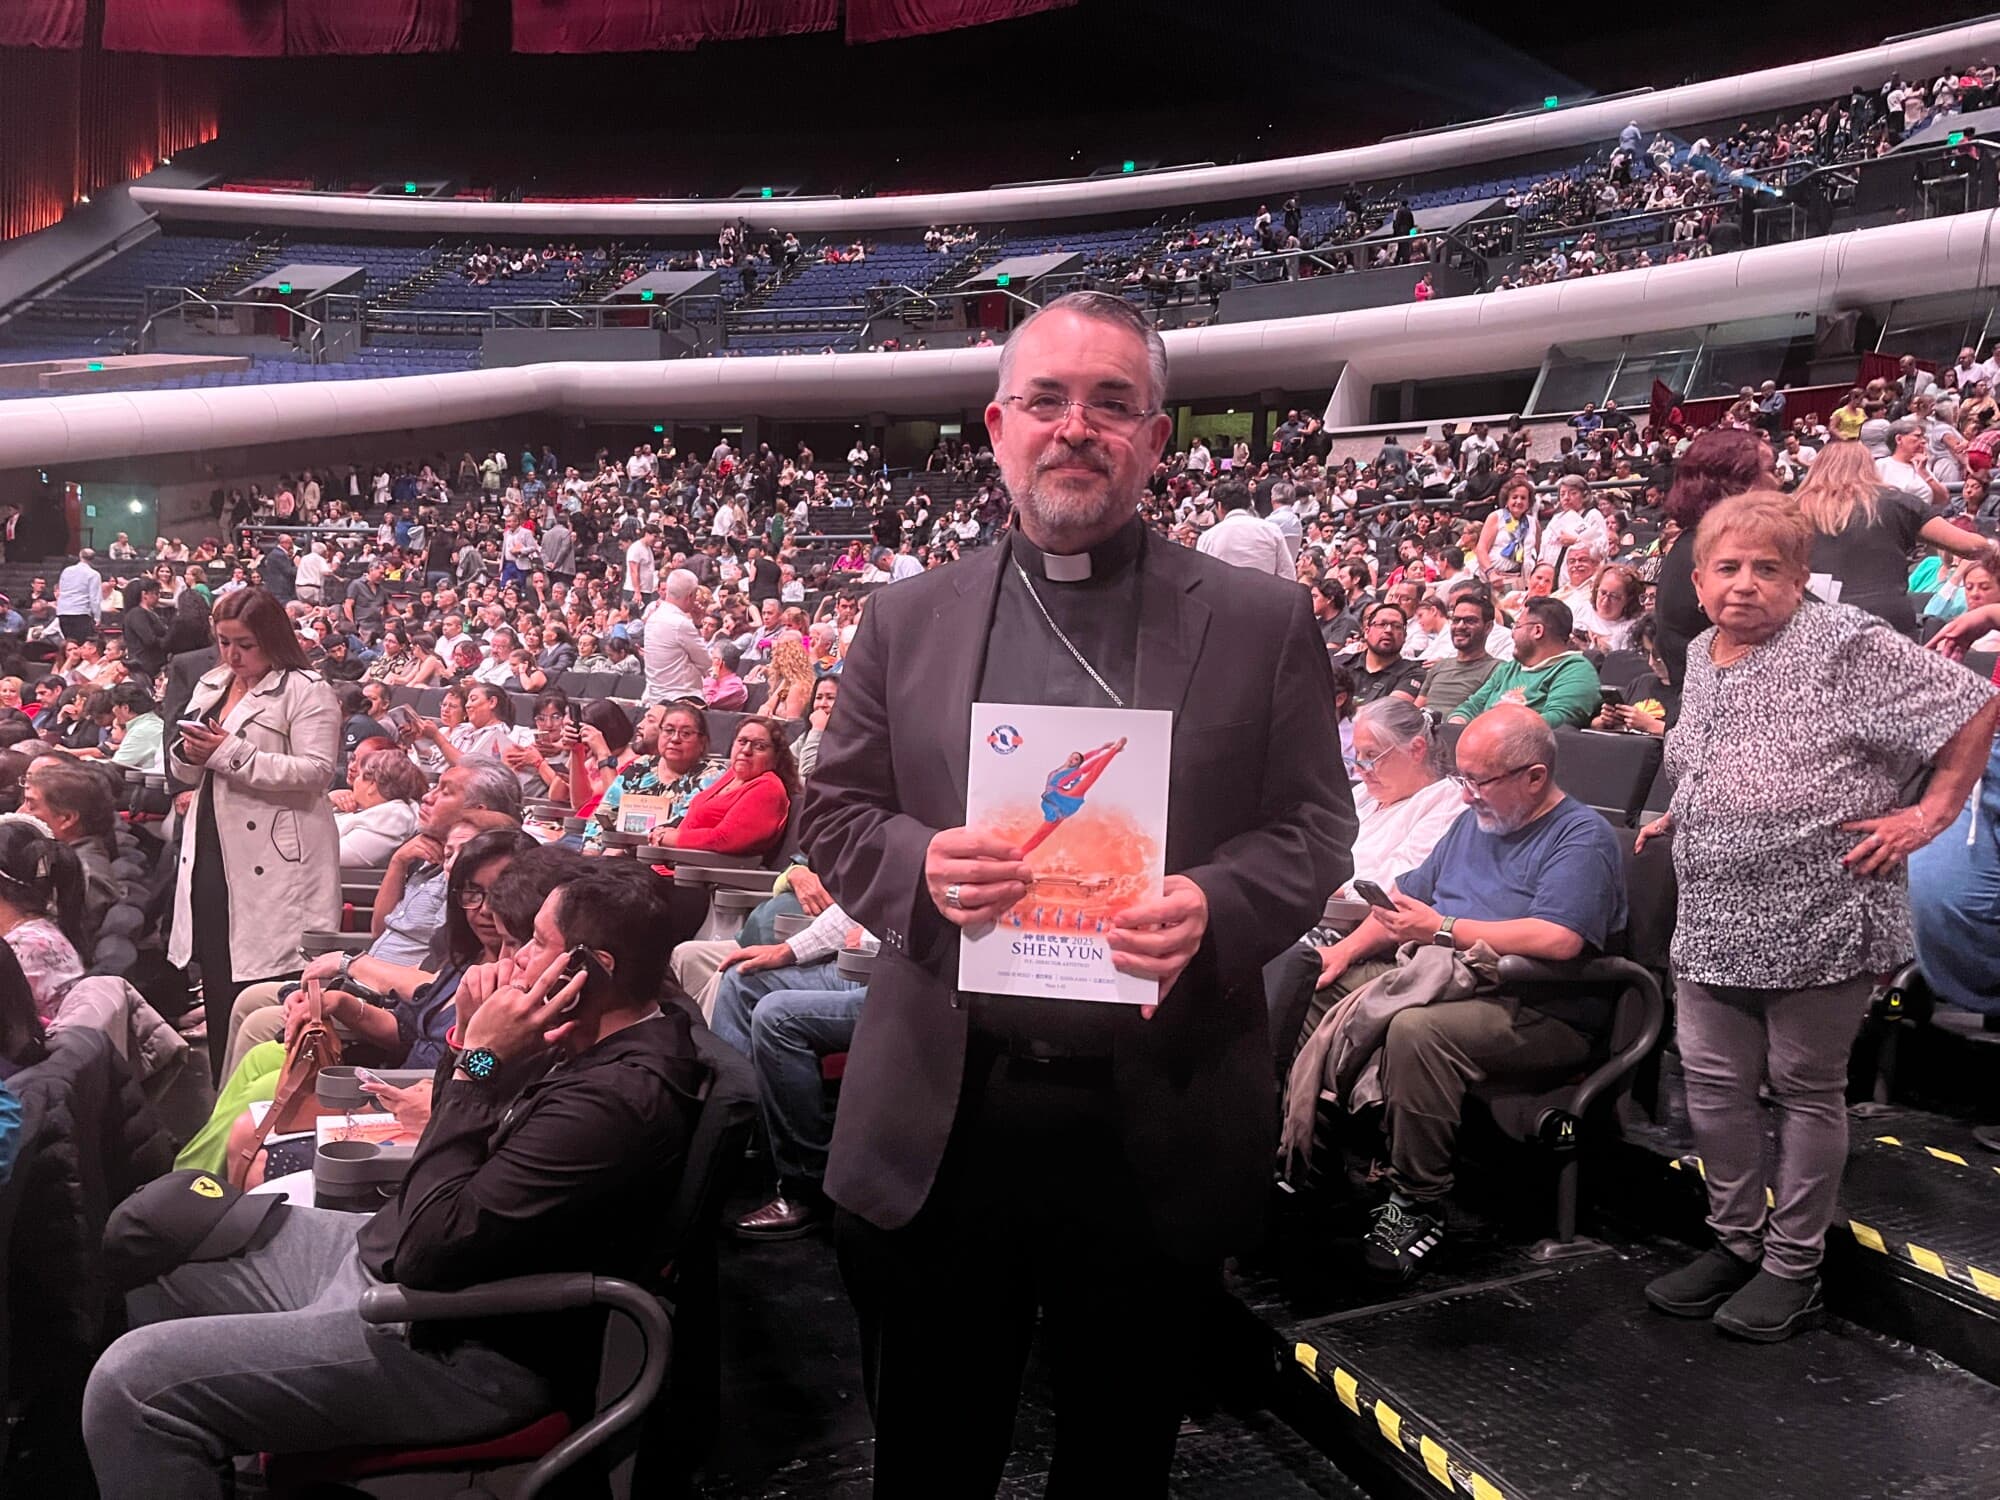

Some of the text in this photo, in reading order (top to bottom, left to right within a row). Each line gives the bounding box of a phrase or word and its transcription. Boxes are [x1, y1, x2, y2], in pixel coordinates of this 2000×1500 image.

[1072, 937, 1094, 946] 2025
[1011, 942, 1103, 960] SHEN YUN
[1561, 1120, 1573, 1136] N
